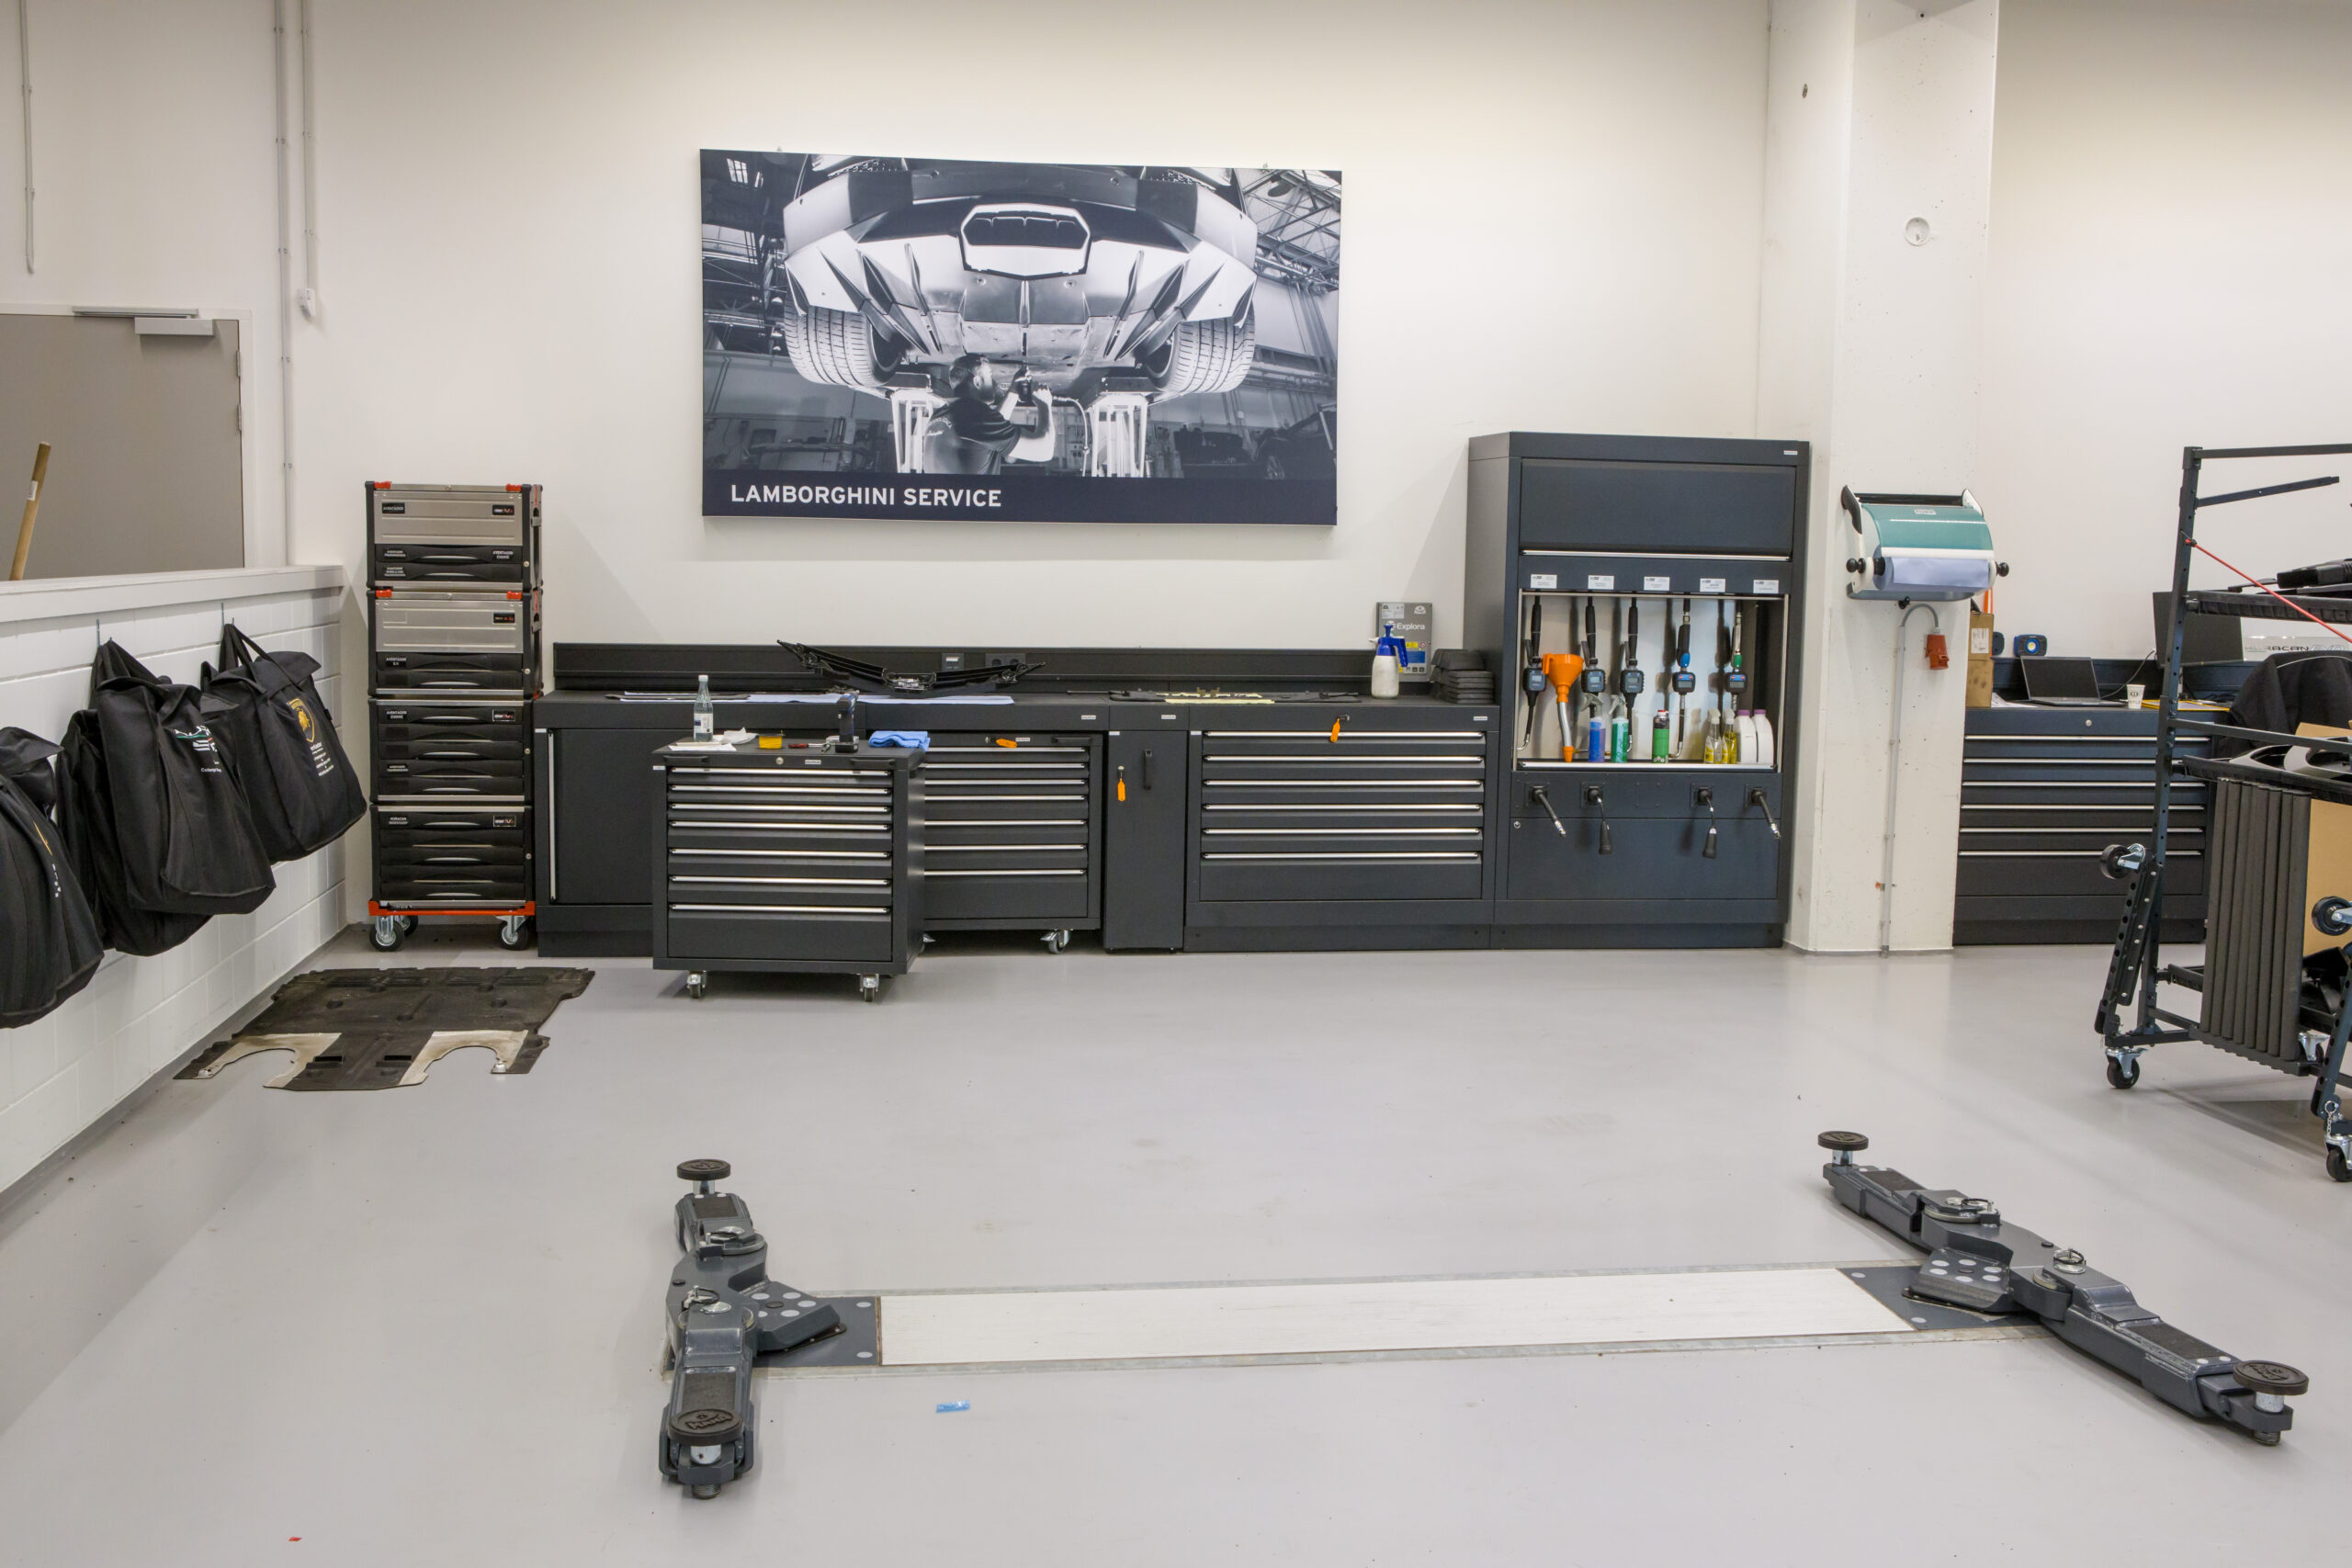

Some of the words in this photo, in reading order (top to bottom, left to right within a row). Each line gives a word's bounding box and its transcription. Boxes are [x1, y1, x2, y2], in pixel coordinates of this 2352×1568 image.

[731, 484, 895, 505] LAMBORGHINI
[903, 488, 1001, 507] SERVICE
[1396, 622, 1426, 632] Explora
